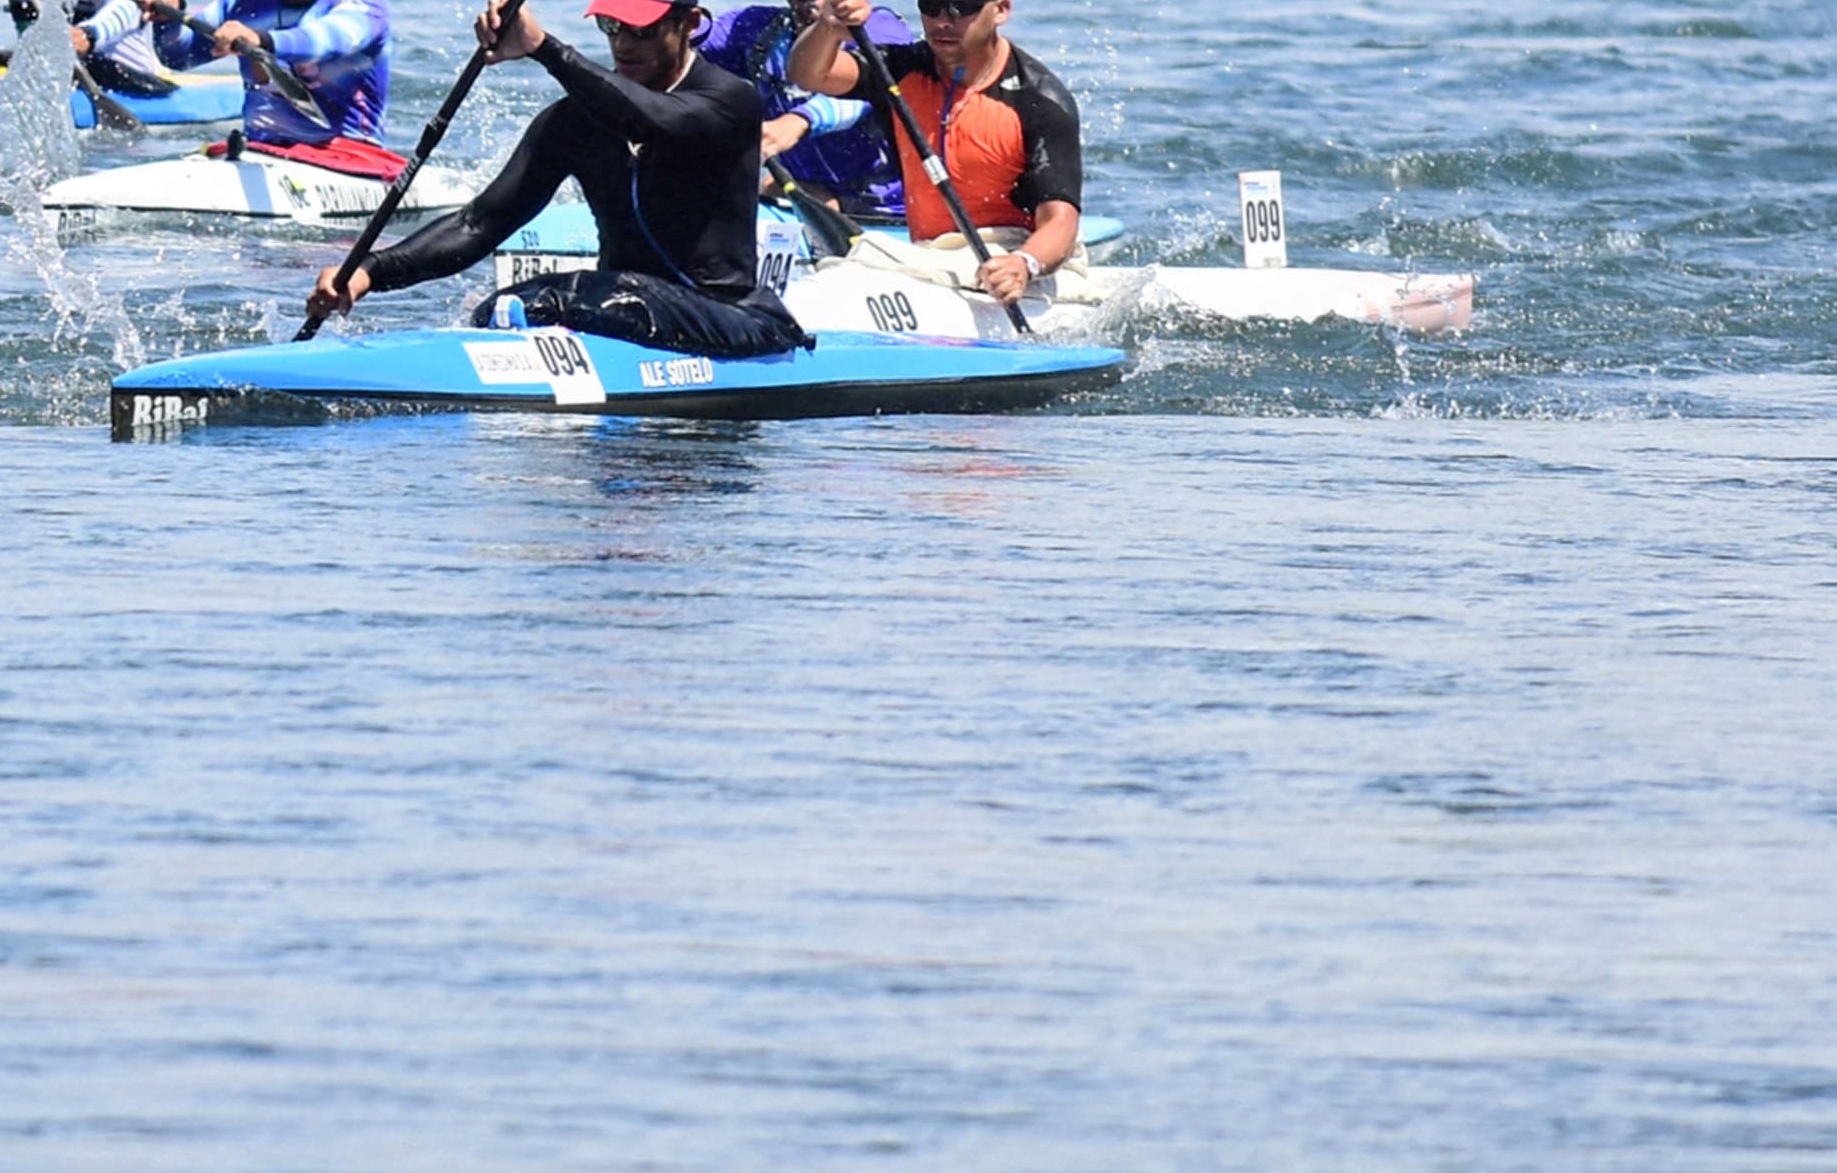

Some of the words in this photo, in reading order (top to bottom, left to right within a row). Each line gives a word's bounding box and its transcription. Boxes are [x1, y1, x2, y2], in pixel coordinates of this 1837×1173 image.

[1246, 199, 1281, 243] 099
[758, 252, 793, 297] 094
[866, 290, 918, 331] 099
[533, 335, 591, 378] 094
